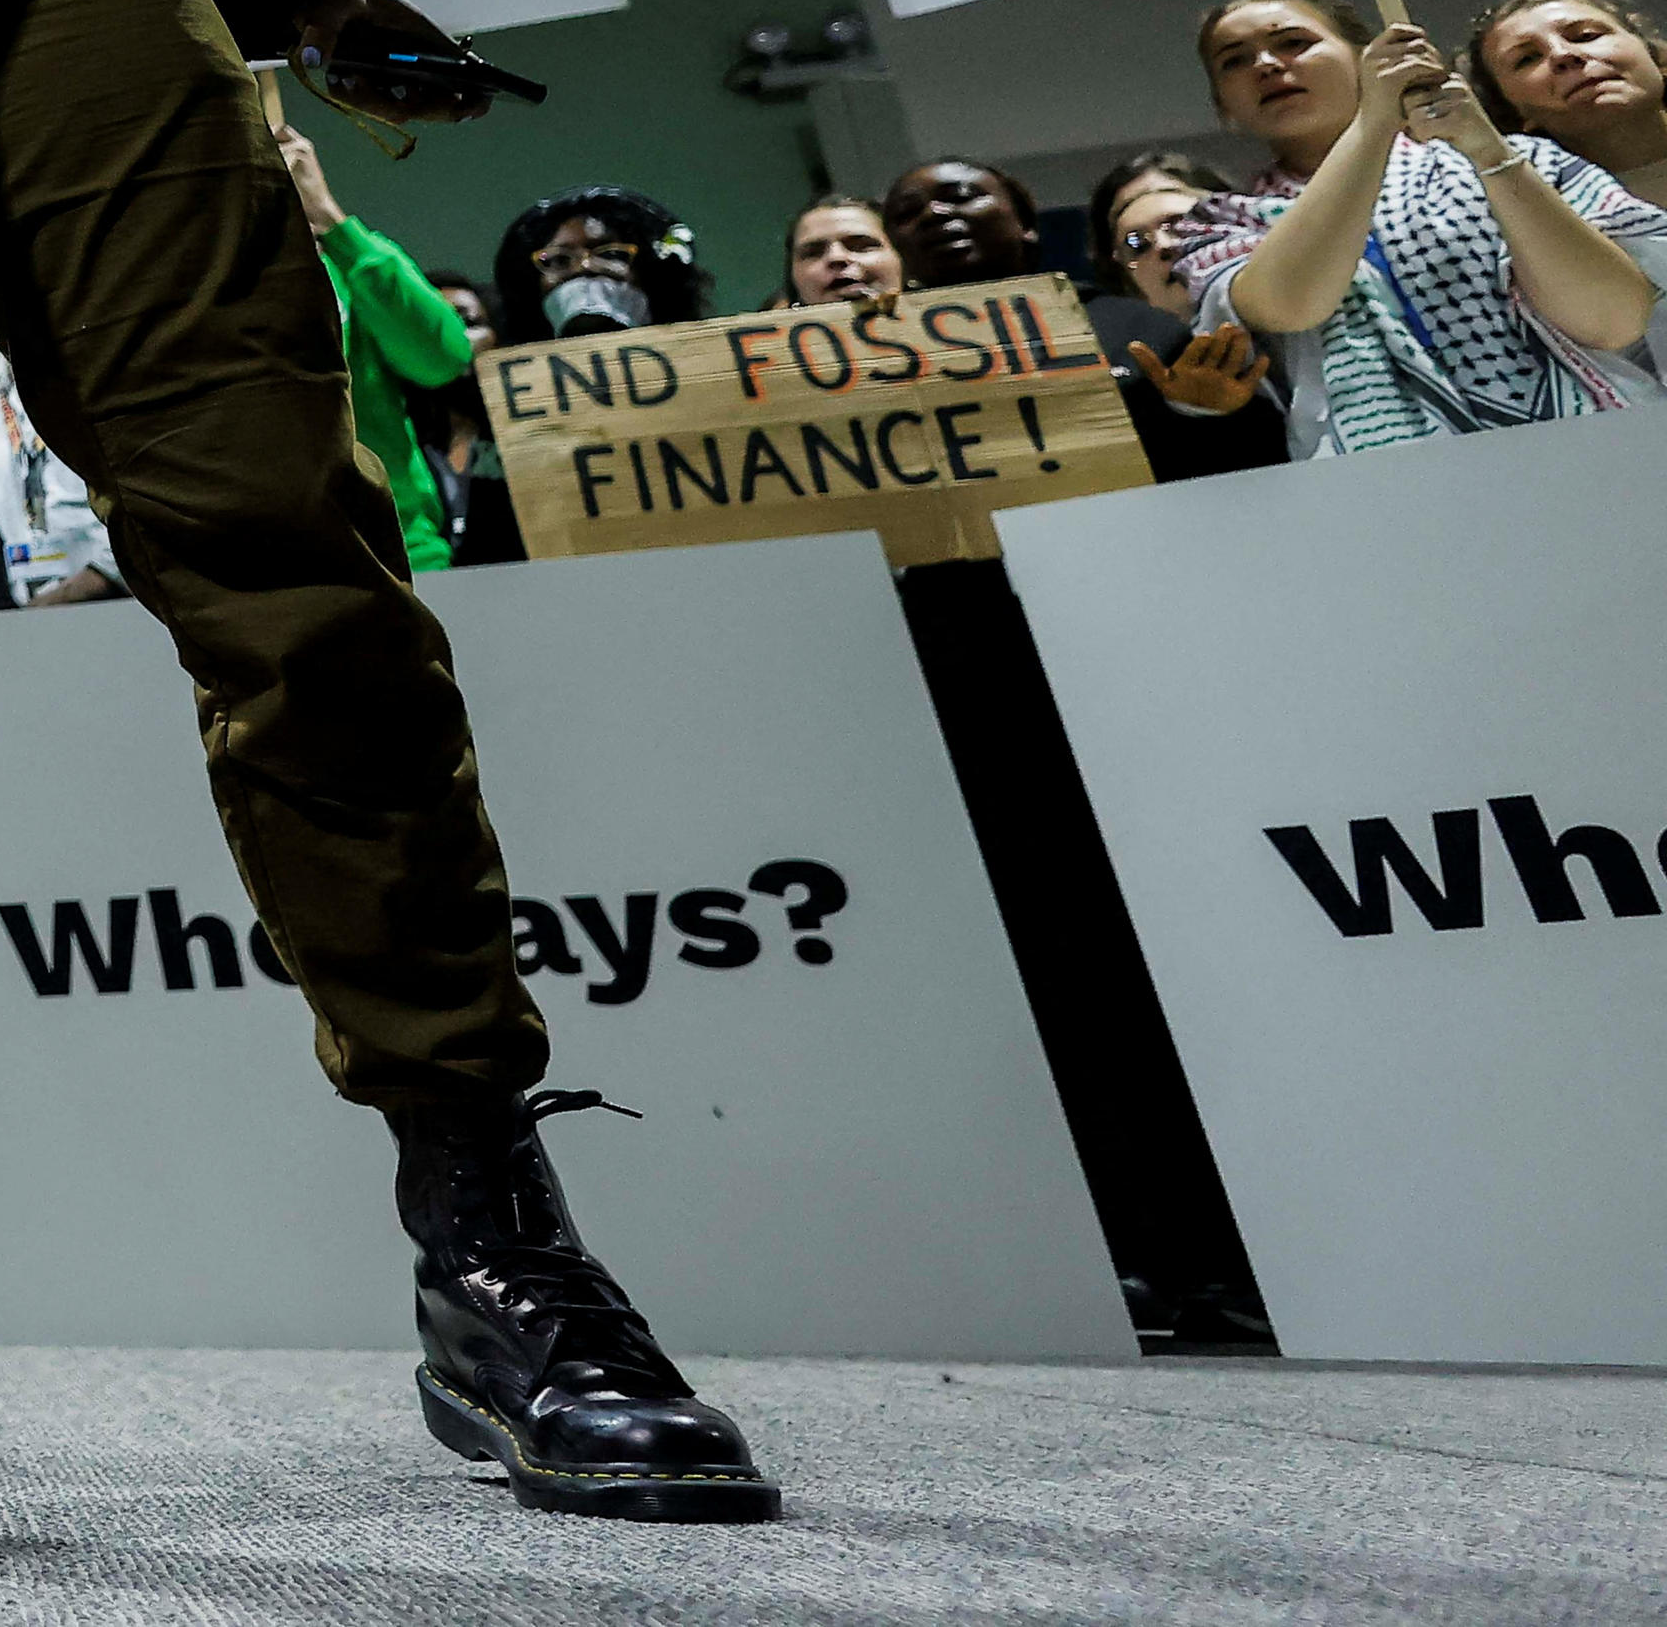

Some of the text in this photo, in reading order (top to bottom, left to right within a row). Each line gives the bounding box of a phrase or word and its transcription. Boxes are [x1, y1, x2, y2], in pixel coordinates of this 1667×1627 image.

[498, 293, 1109, 422] END FOSSIL
[511, 856, 850, 1006] ays?
[1263, 795, 1667, 937] Wh
